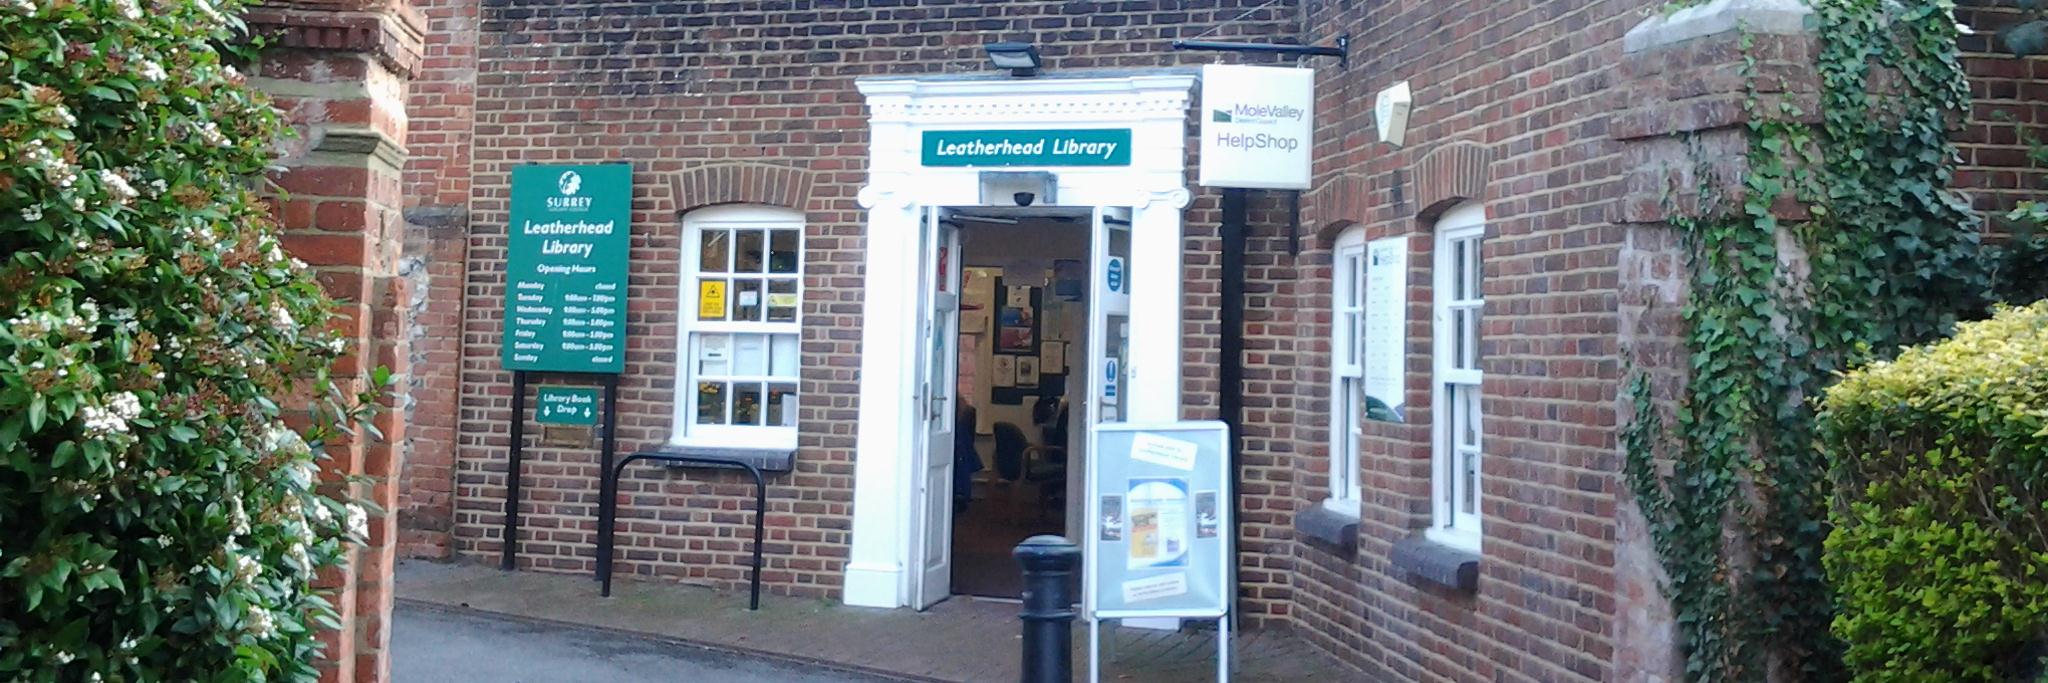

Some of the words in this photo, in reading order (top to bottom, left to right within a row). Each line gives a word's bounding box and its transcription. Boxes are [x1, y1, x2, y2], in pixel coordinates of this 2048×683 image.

[1235, 103, 1304, 122] MoleValley
[936, 138, 1045, 156] Leatherhead
[1052, 138, 1118, 160] Library
[1217, 132, 1298, 152] HelpShop
[546, 197, 592, 208] SURREY
[524, 220, 614, 235] Leatherhead
[542, 239, 593, 258] Library
[537, 264, 571, 274] Opening
[571, 264, 597, 274] Hours
[543, 393, 570, 404] Library
[571, 394, 592, 403] Book
[556, 404, 578, 415] Drop
